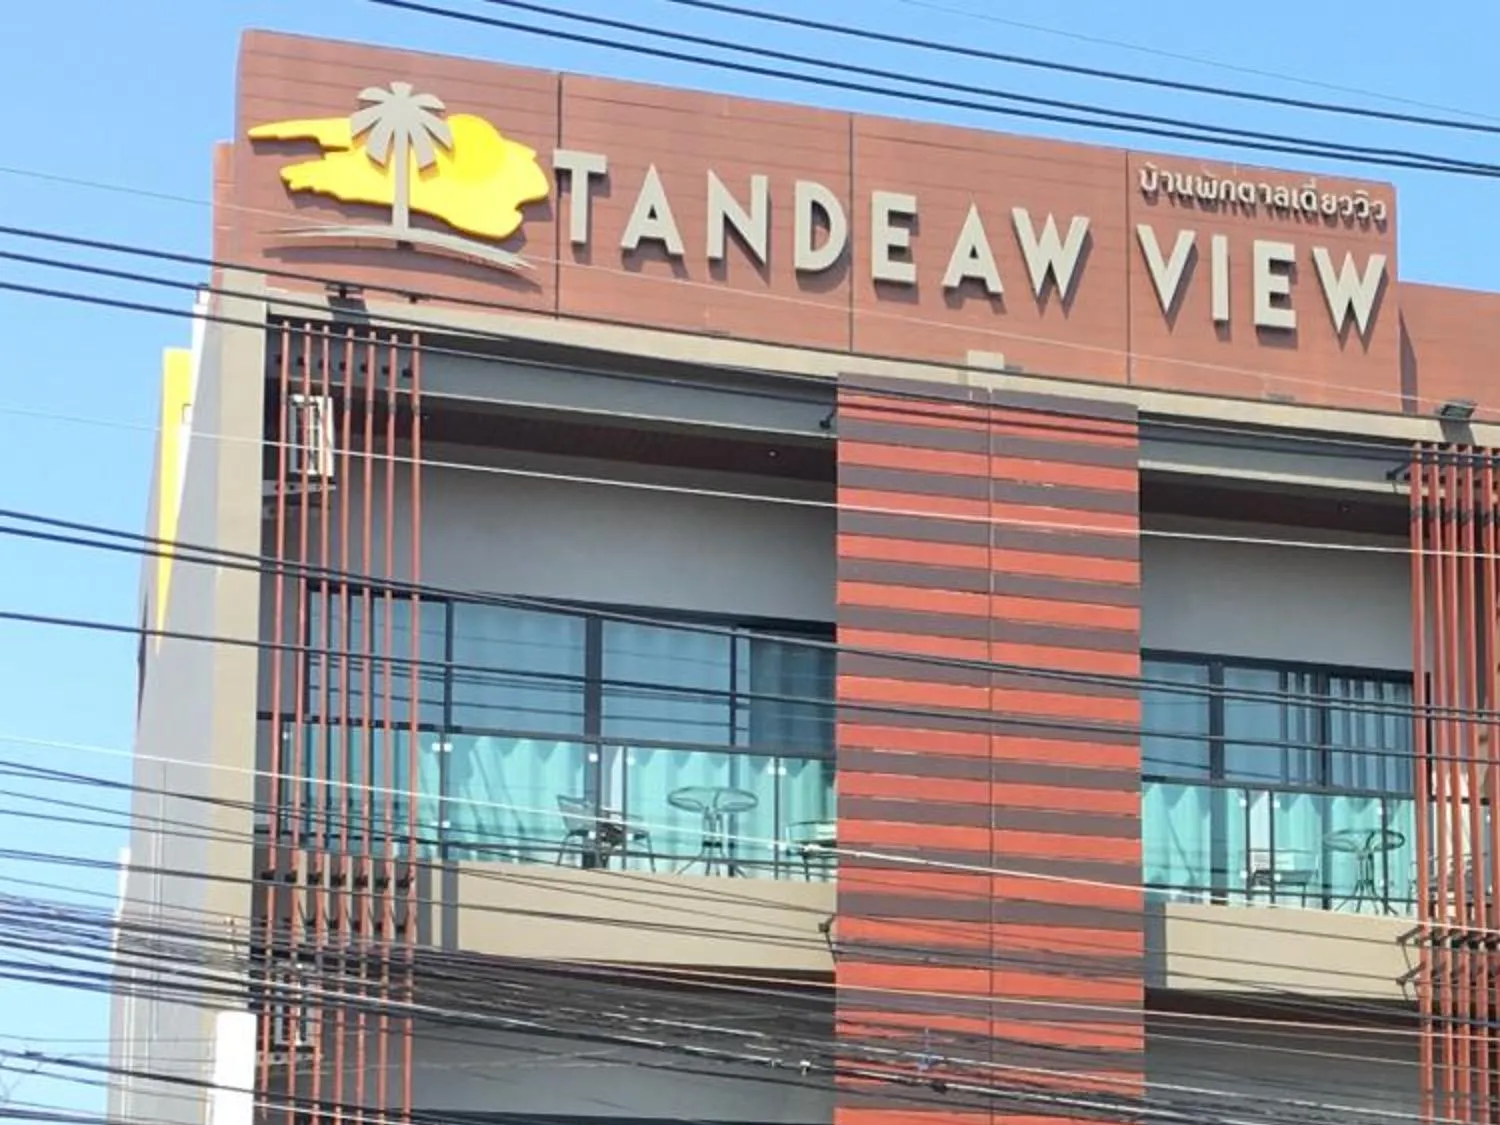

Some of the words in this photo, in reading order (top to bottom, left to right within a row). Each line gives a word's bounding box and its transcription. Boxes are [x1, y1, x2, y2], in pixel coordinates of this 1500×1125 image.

[552, 148, 1091, 301] TANDEAW
[1136, 223, 1386, 337] VIEW
[1139, 162, 1387, 220] บ้านพักตาลเดี่ยววิว
